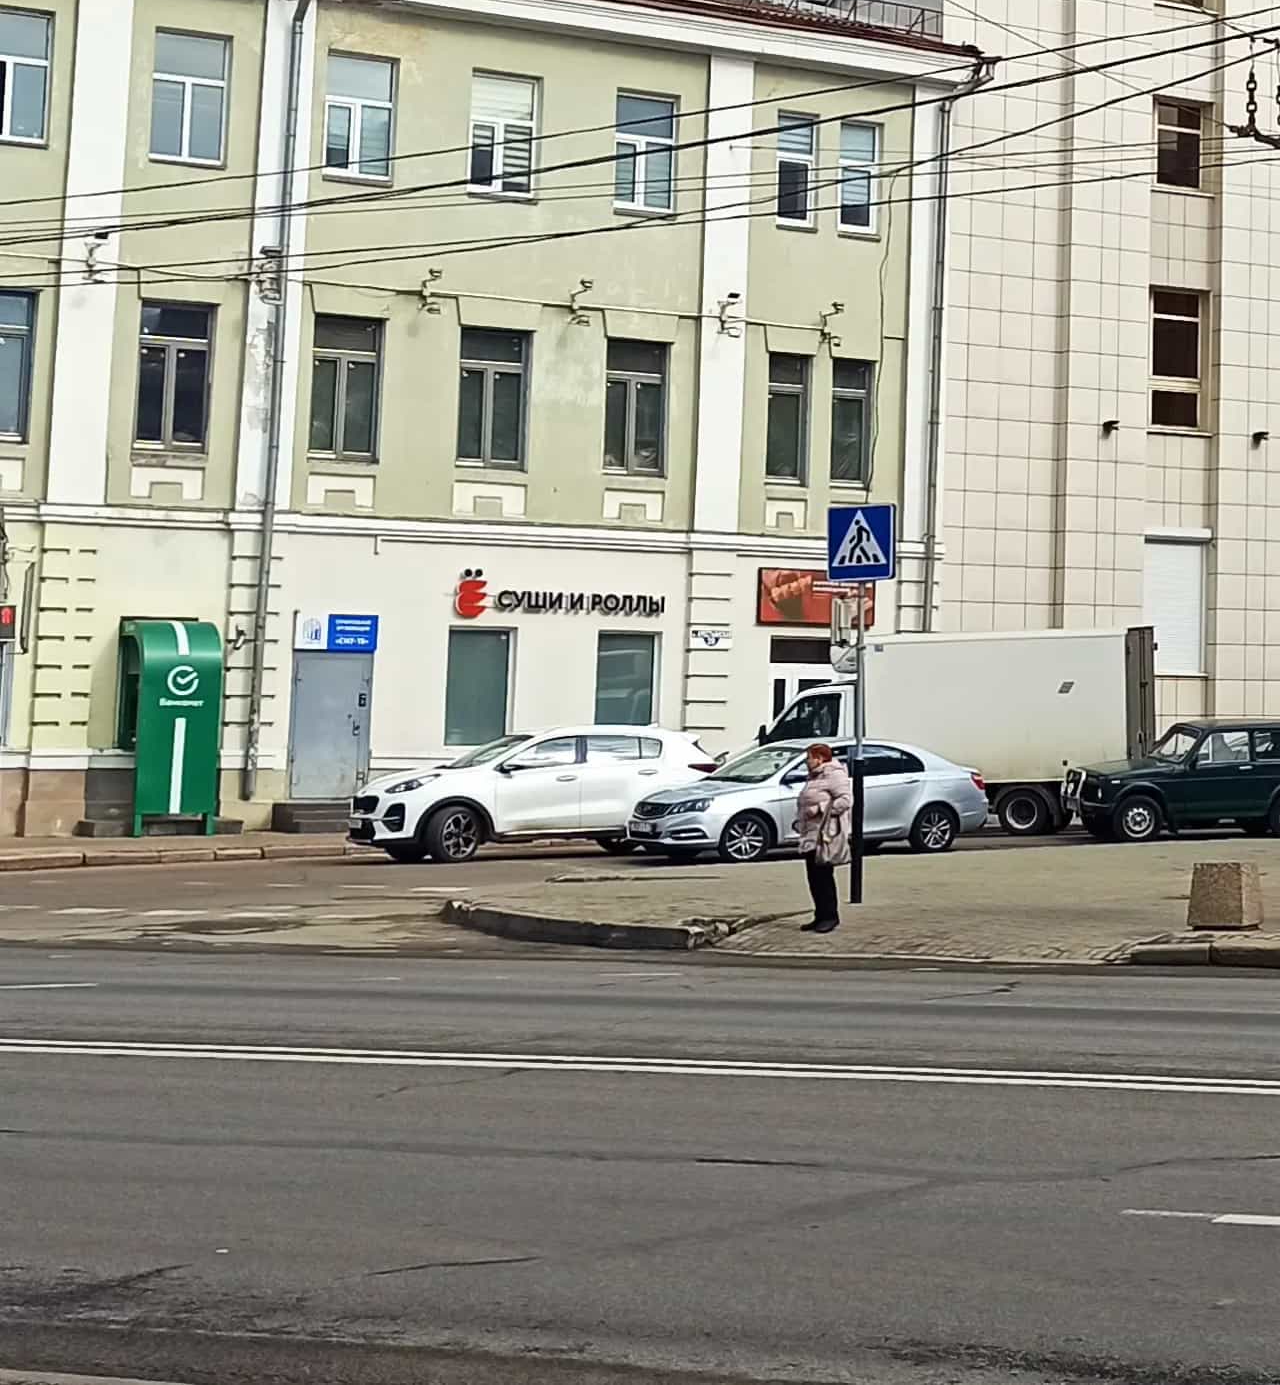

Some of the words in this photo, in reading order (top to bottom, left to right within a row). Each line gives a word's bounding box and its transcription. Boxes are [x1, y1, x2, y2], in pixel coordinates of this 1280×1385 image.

[497, 590, 564, 613] СУШИ
[568, 592, 583, 611] И
[590, 594, 666, 616] РОЛЛЫ
